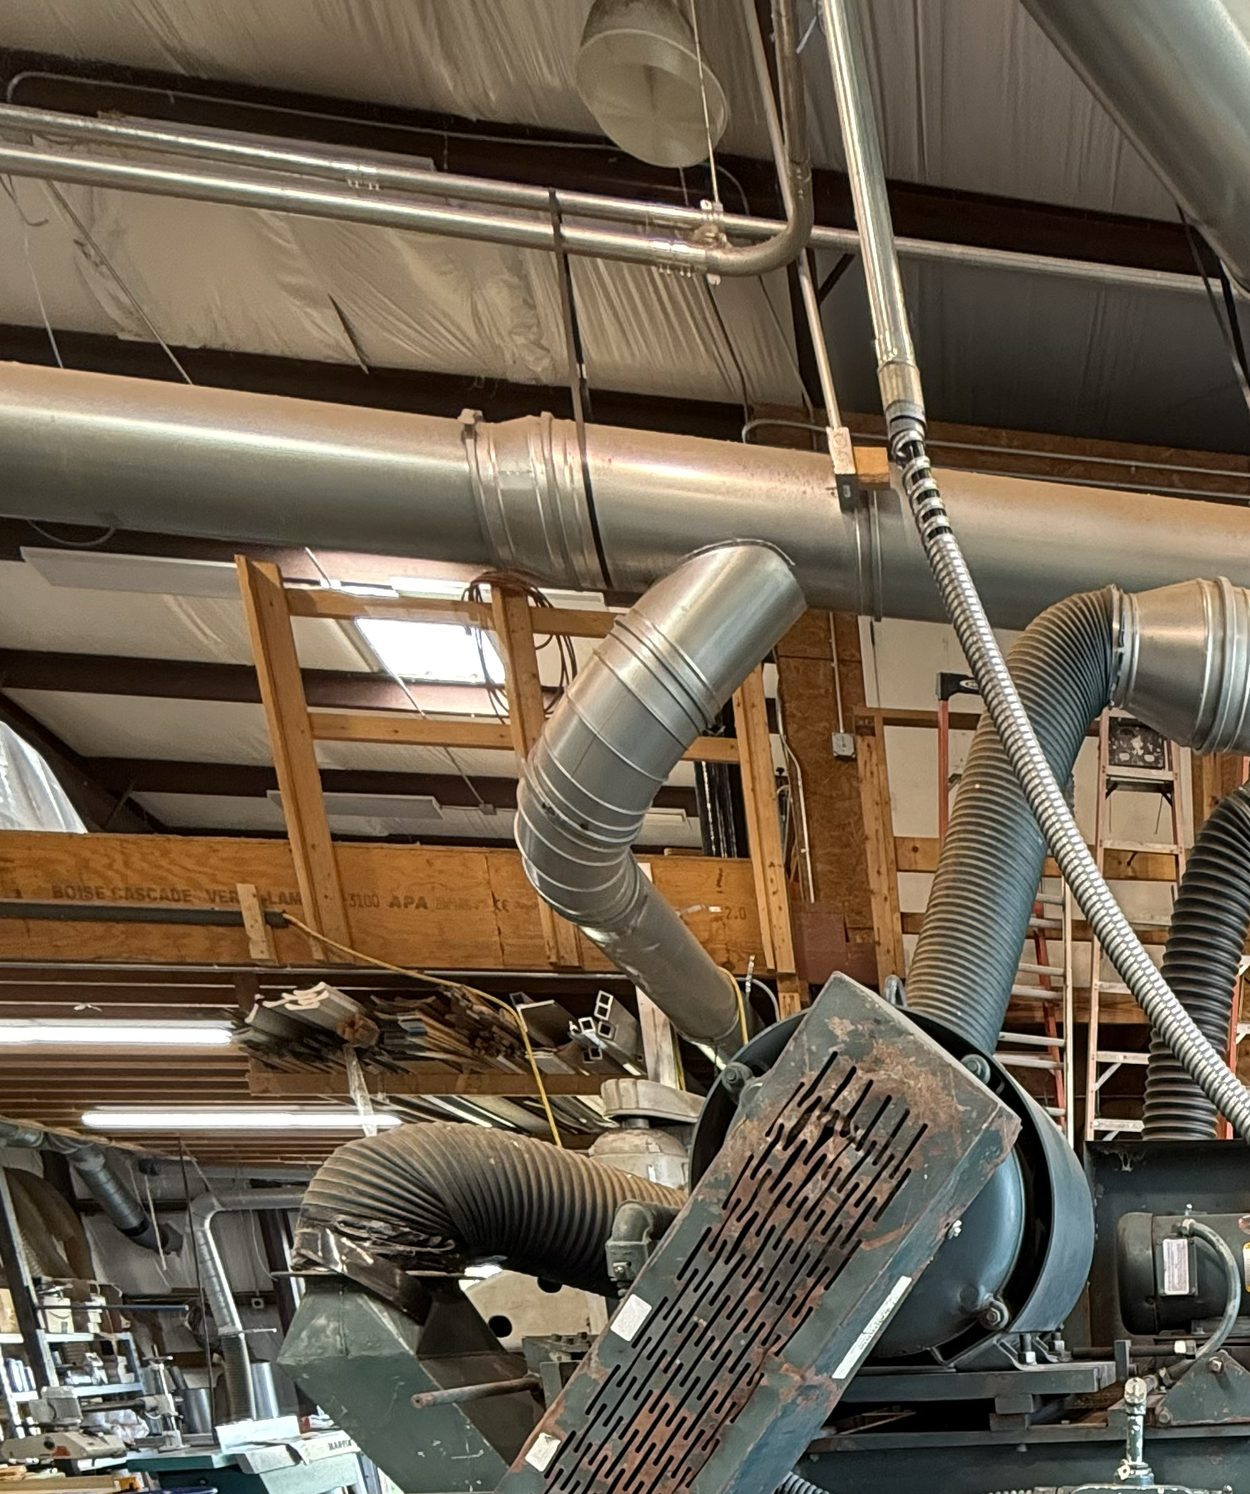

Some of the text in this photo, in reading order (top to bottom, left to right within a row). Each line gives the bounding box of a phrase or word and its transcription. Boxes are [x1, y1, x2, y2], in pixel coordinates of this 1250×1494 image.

[51, 884, 106, 901] BOISE
[110, 886, 192, 903] CASCADE
[387, 894, 429, 910] APA
